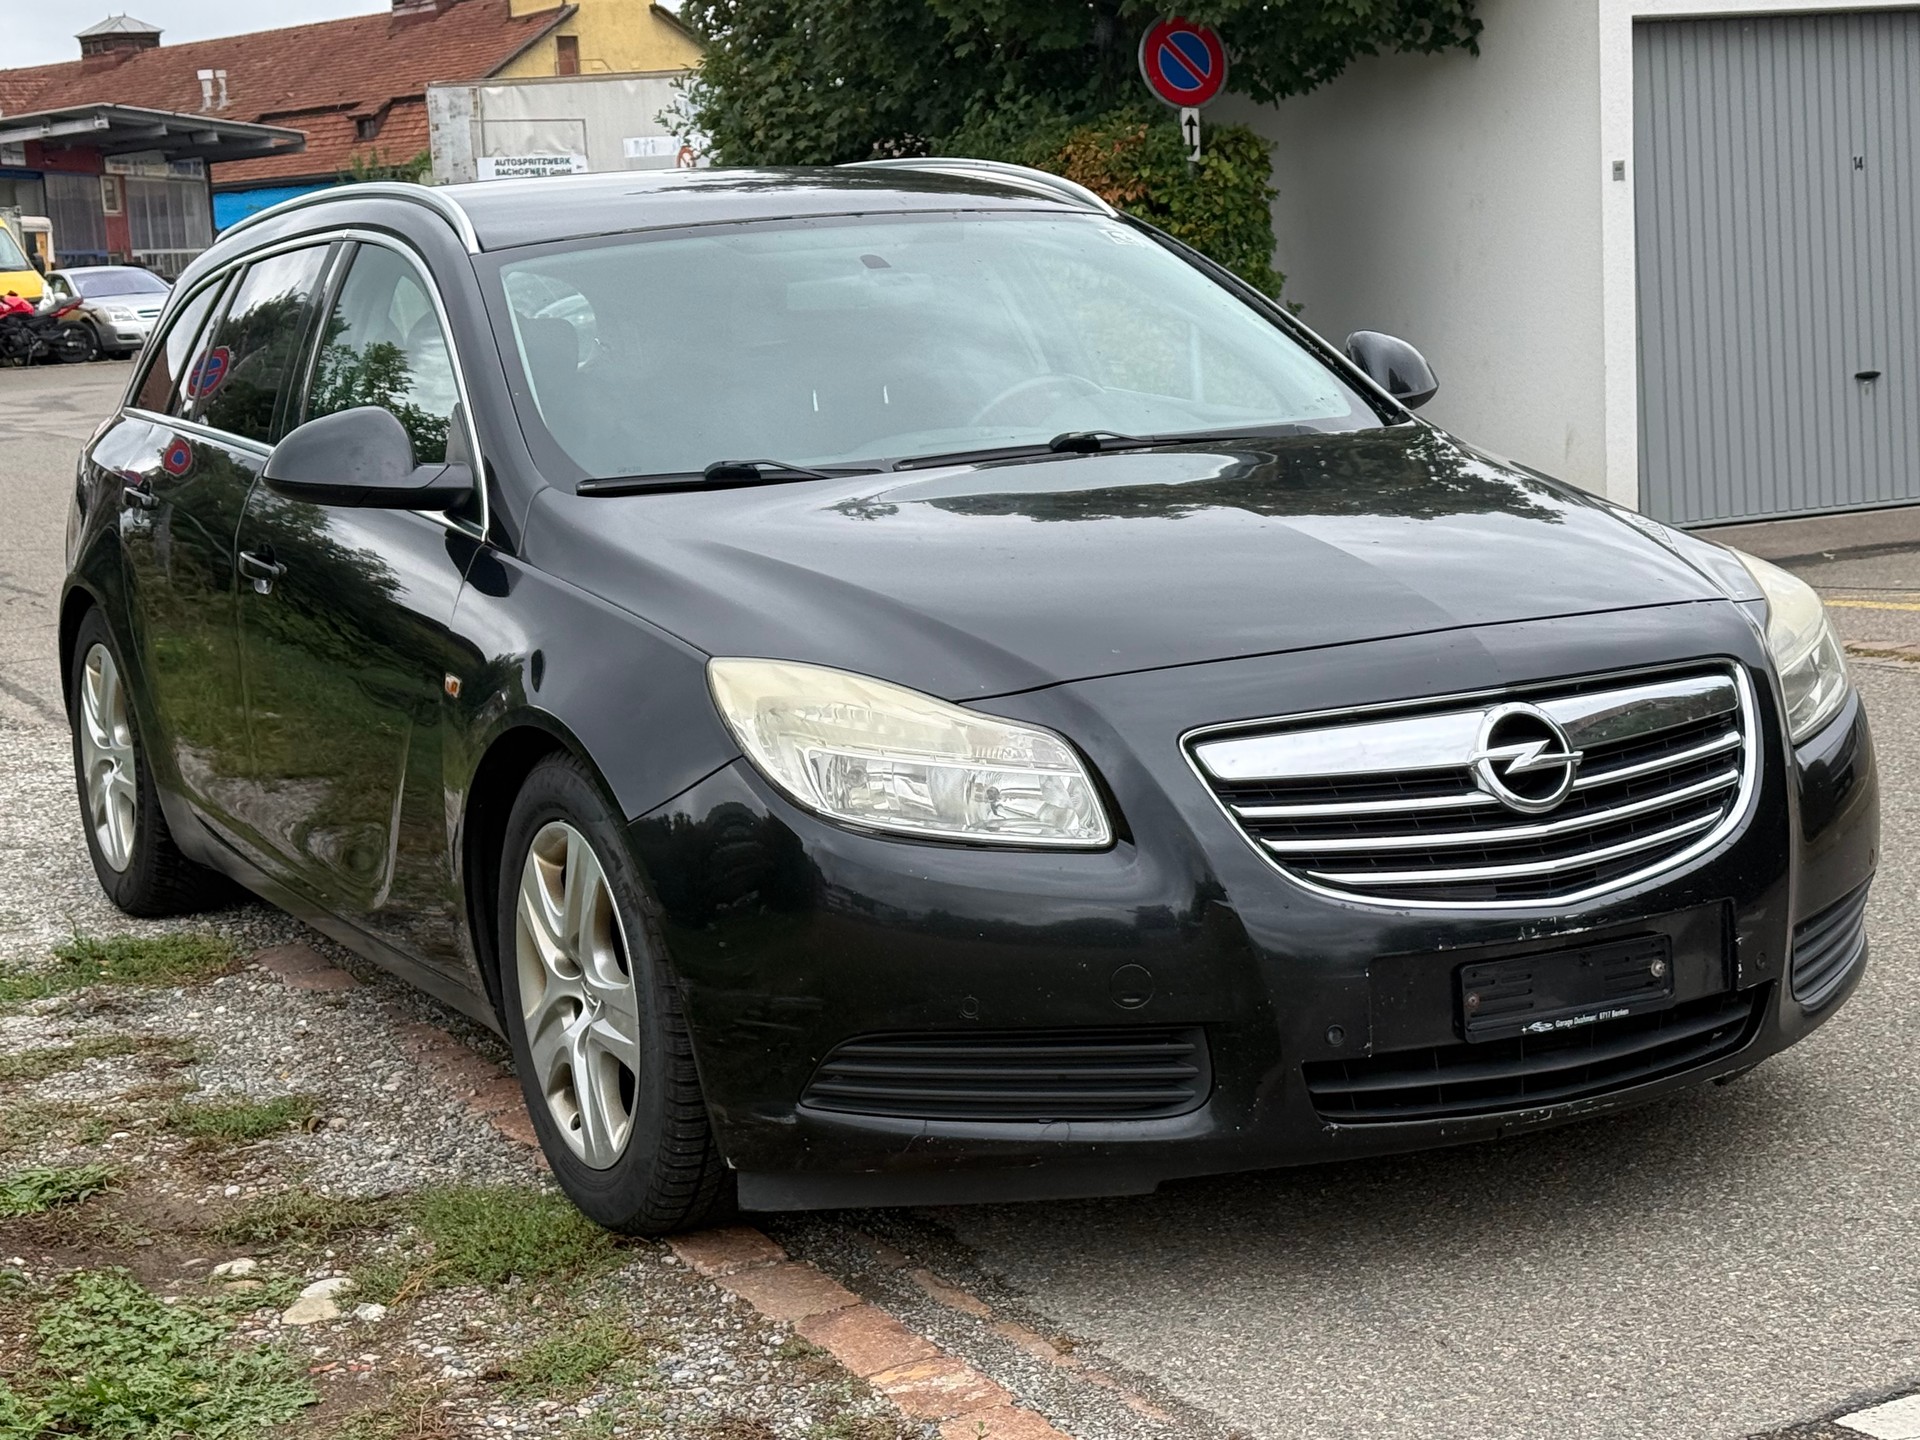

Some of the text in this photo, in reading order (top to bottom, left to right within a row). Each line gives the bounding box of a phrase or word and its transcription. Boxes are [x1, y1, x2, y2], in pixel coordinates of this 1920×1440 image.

[494, 157, 571, 167] AUTOSPRITZWERK
[1853, 156, 1863, 171] 14
[495, 167, 547, 177] BACHOFNER
[1555, 1019, 1573, 1028] Garage
